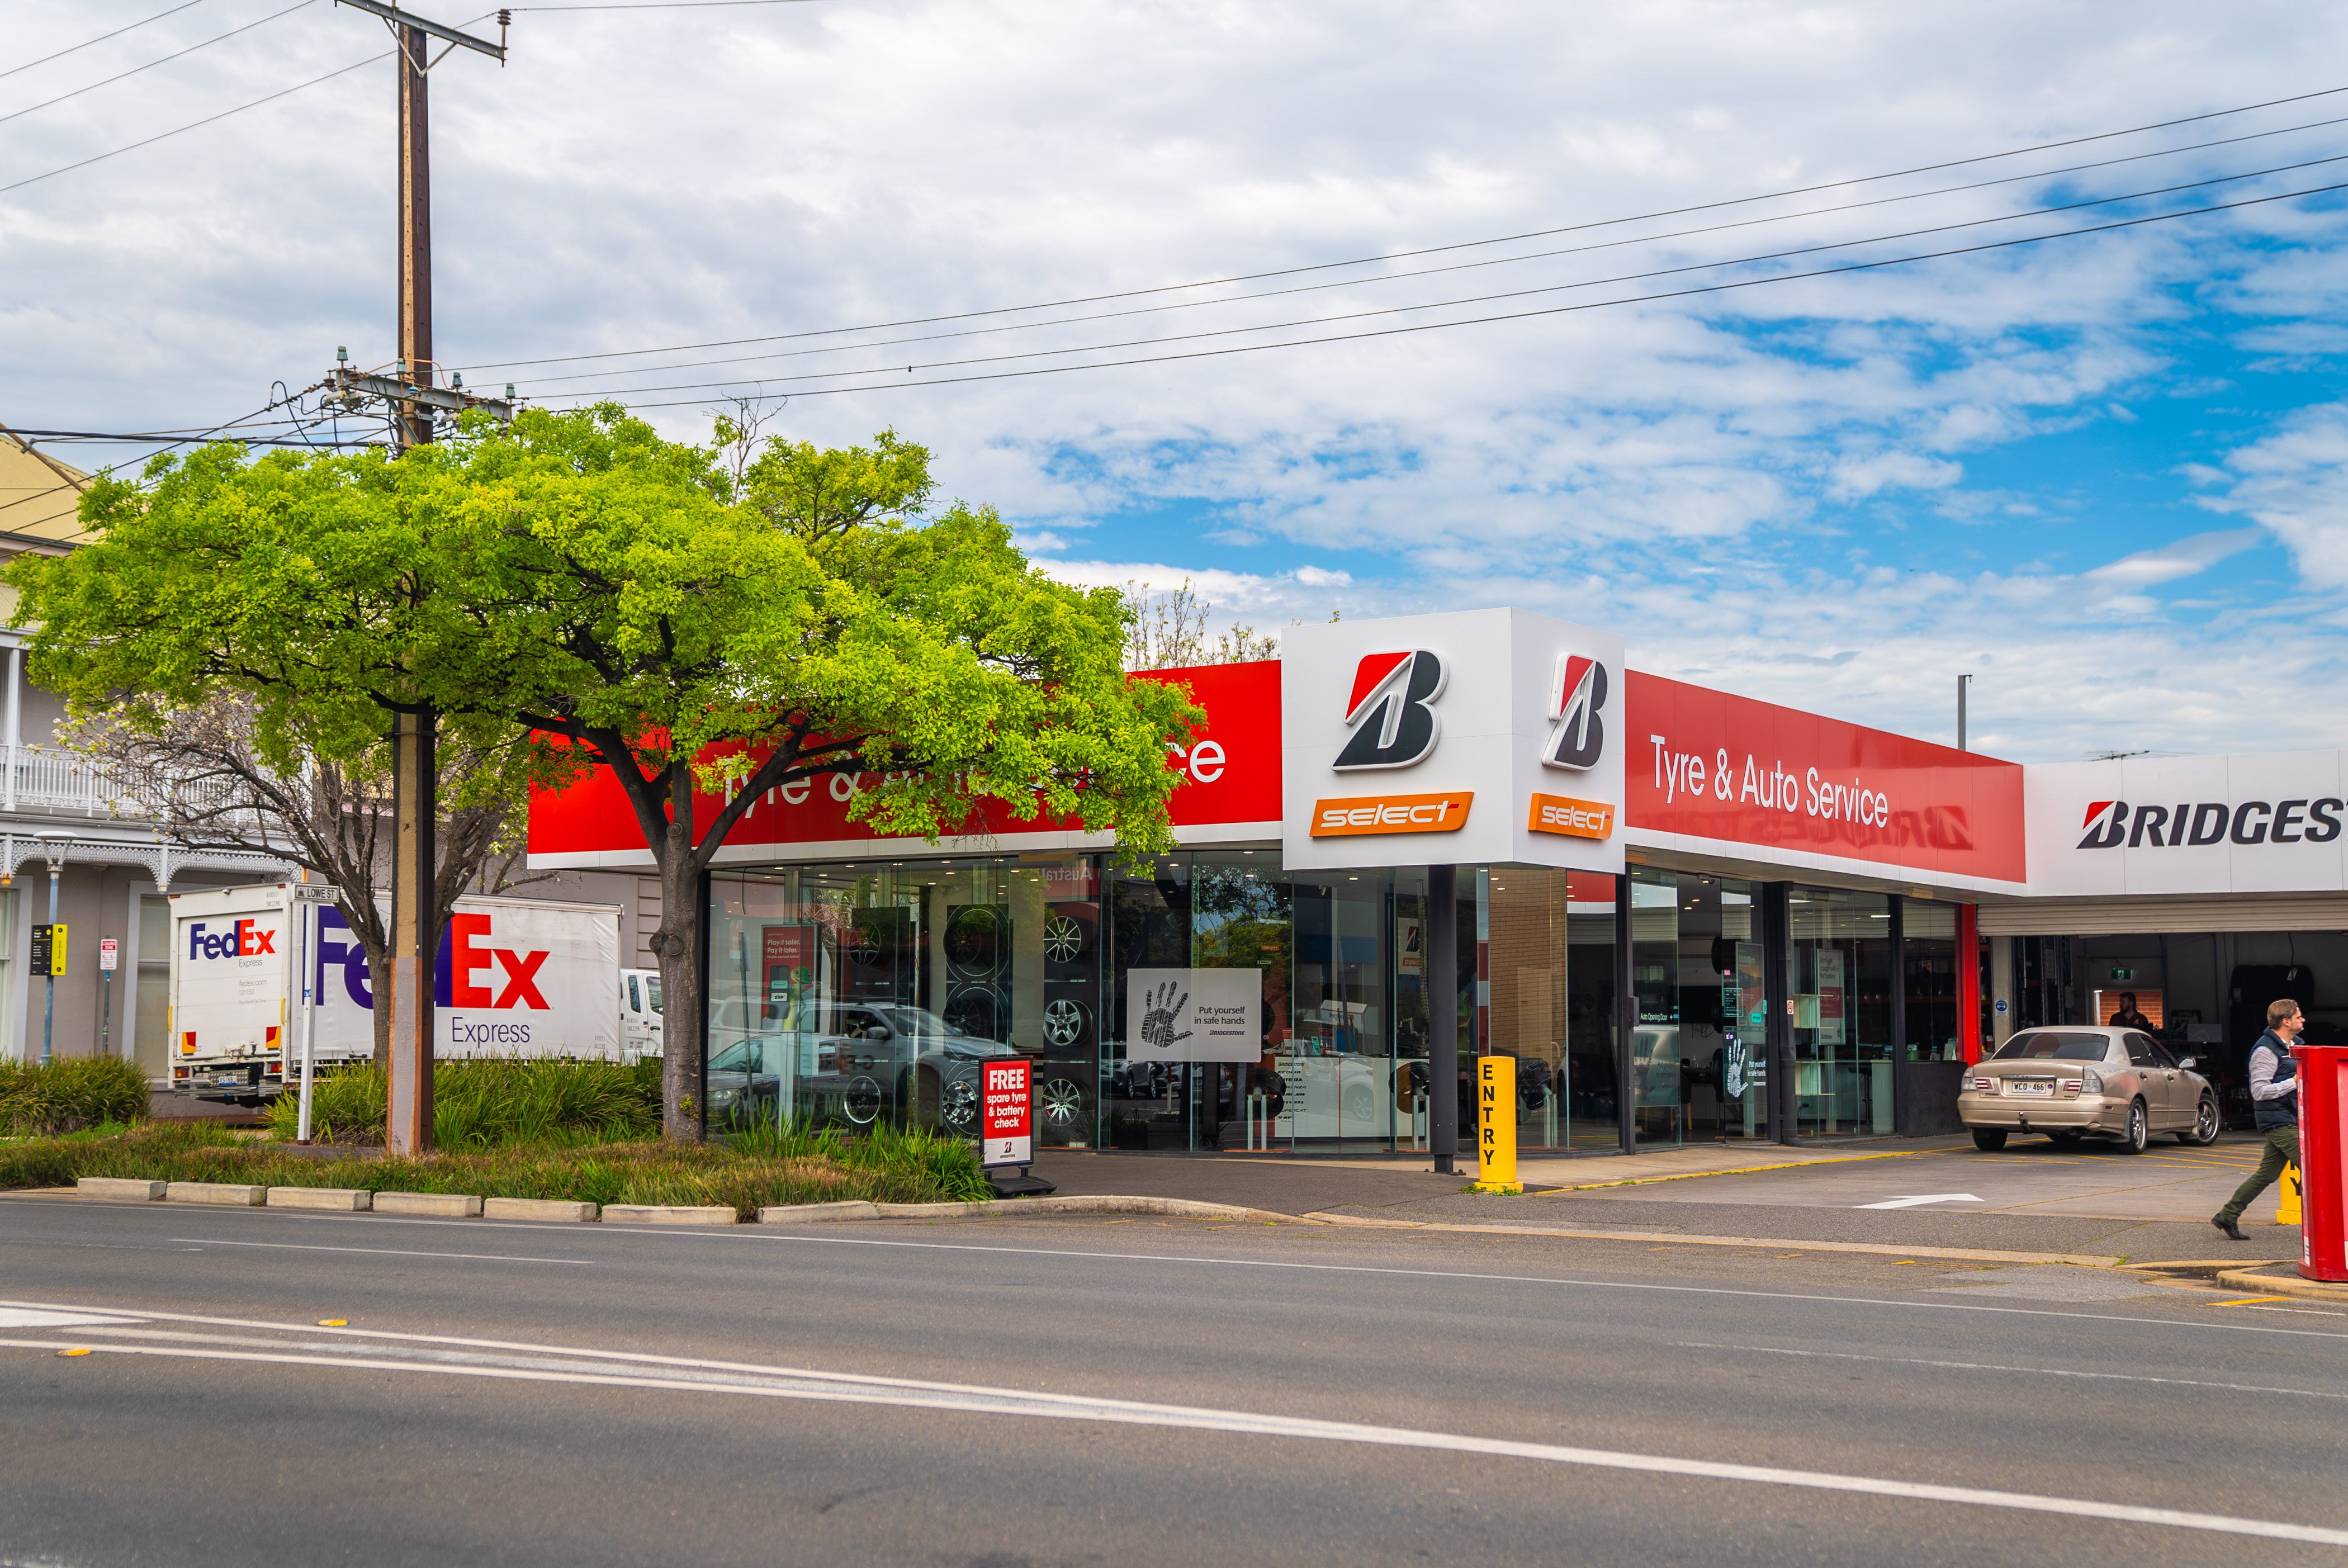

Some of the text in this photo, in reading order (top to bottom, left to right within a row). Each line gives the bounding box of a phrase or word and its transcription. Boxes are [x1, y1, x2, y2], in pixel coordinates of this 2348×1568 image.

[1650, 734, 1888, 828] Tyre & Auto Service
[1320, 799, 1460, 828] select
[1541, 804, 1611, 831] select
[2076, 797, 2348, 849] BRIDGES
[307, 888, 335, 899] LOWE ST
[190, 918, 276, 960] FedEx
[239, 959, 263, 968] Express
[1214, 1006, 1246, 1016] yourself
[1648, 1013, 1660, 1022] Opening
[1203, 1016, 1219, 1025] safe
[1221, 1016, 1245, 1025] hands
[452, 1016, 530, 1049] Express
[1754, 1060, 1766, 1069] yourself
[989, 1069, 1025, 1091] FREE
[987, 1092, 1027, 1106] spare tyre
[988, 1105, 1025, 1117] & battery
[1483, 1064, 1495, 1166] ENTRY
[995, 1117, 1019, 1129] check
